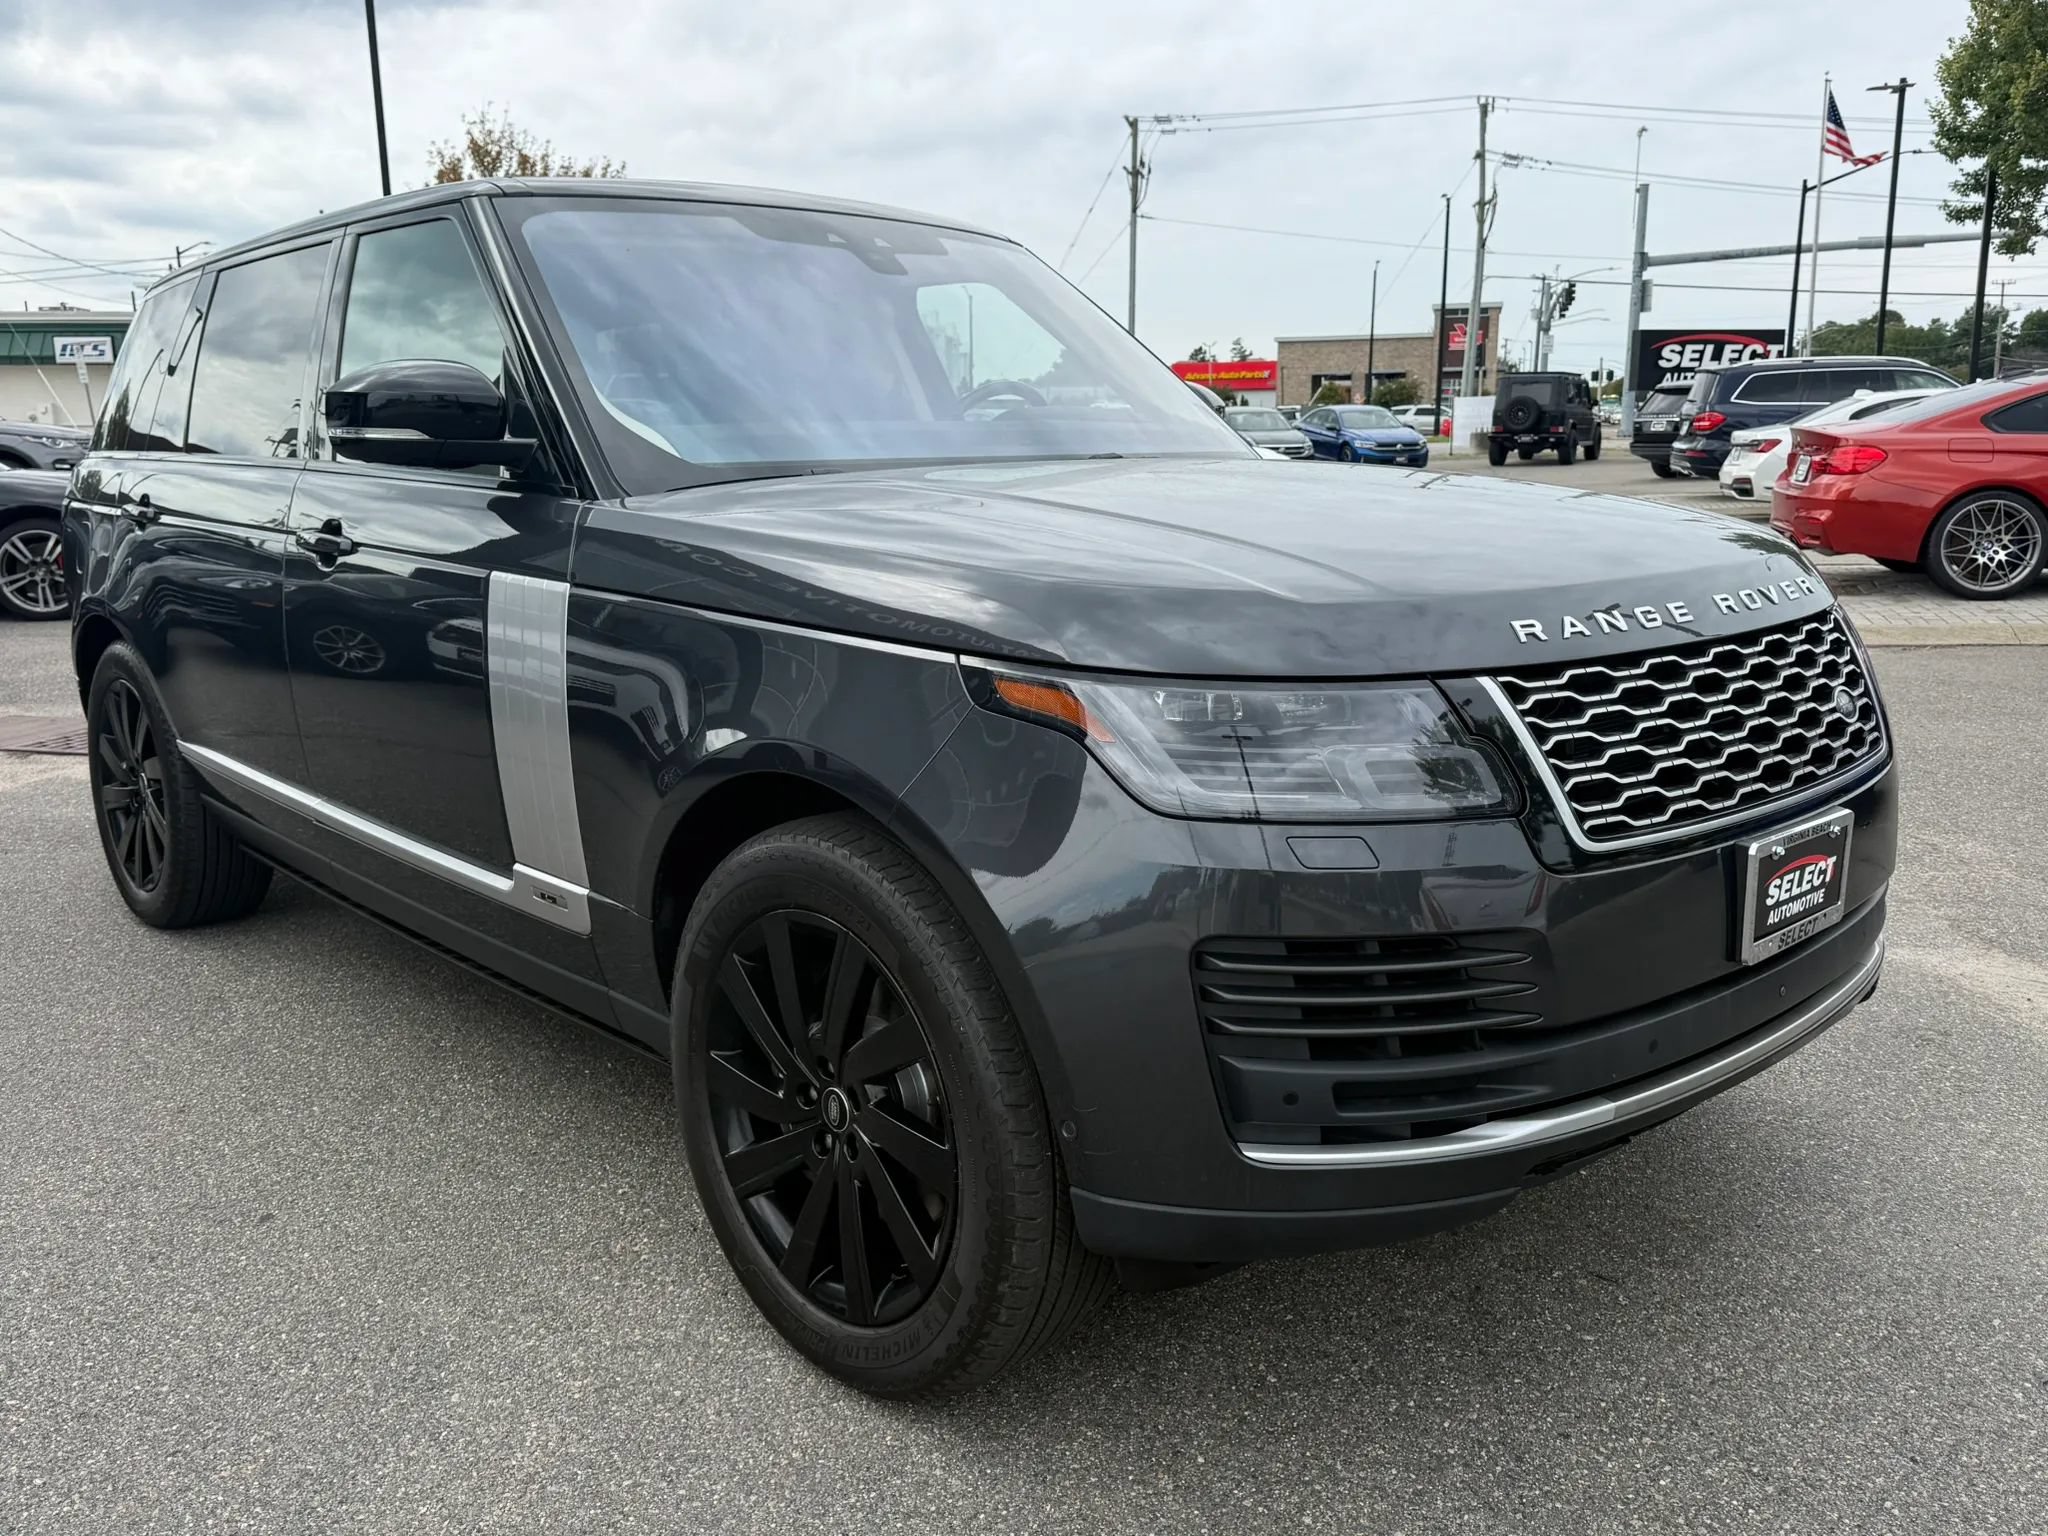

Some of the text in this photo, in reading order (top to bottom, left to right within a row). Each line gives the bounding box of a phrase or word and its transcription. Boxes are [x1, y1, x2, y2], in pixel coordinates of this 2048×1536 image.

[1657, 344, 1785, 368] SELECT
[1510, 576, 1815, 643] RANGE ROVER
[1782, 821, 1832, 847] VIRGINIA BEACH
[1766, 856, 1837, 906] SELECT
[1767, 888, 1826, 926] AUTOMOTIVE
[1778, 918, 1817, 950] SELECT
[842, 1327, 921, 1361] MICHELIN
